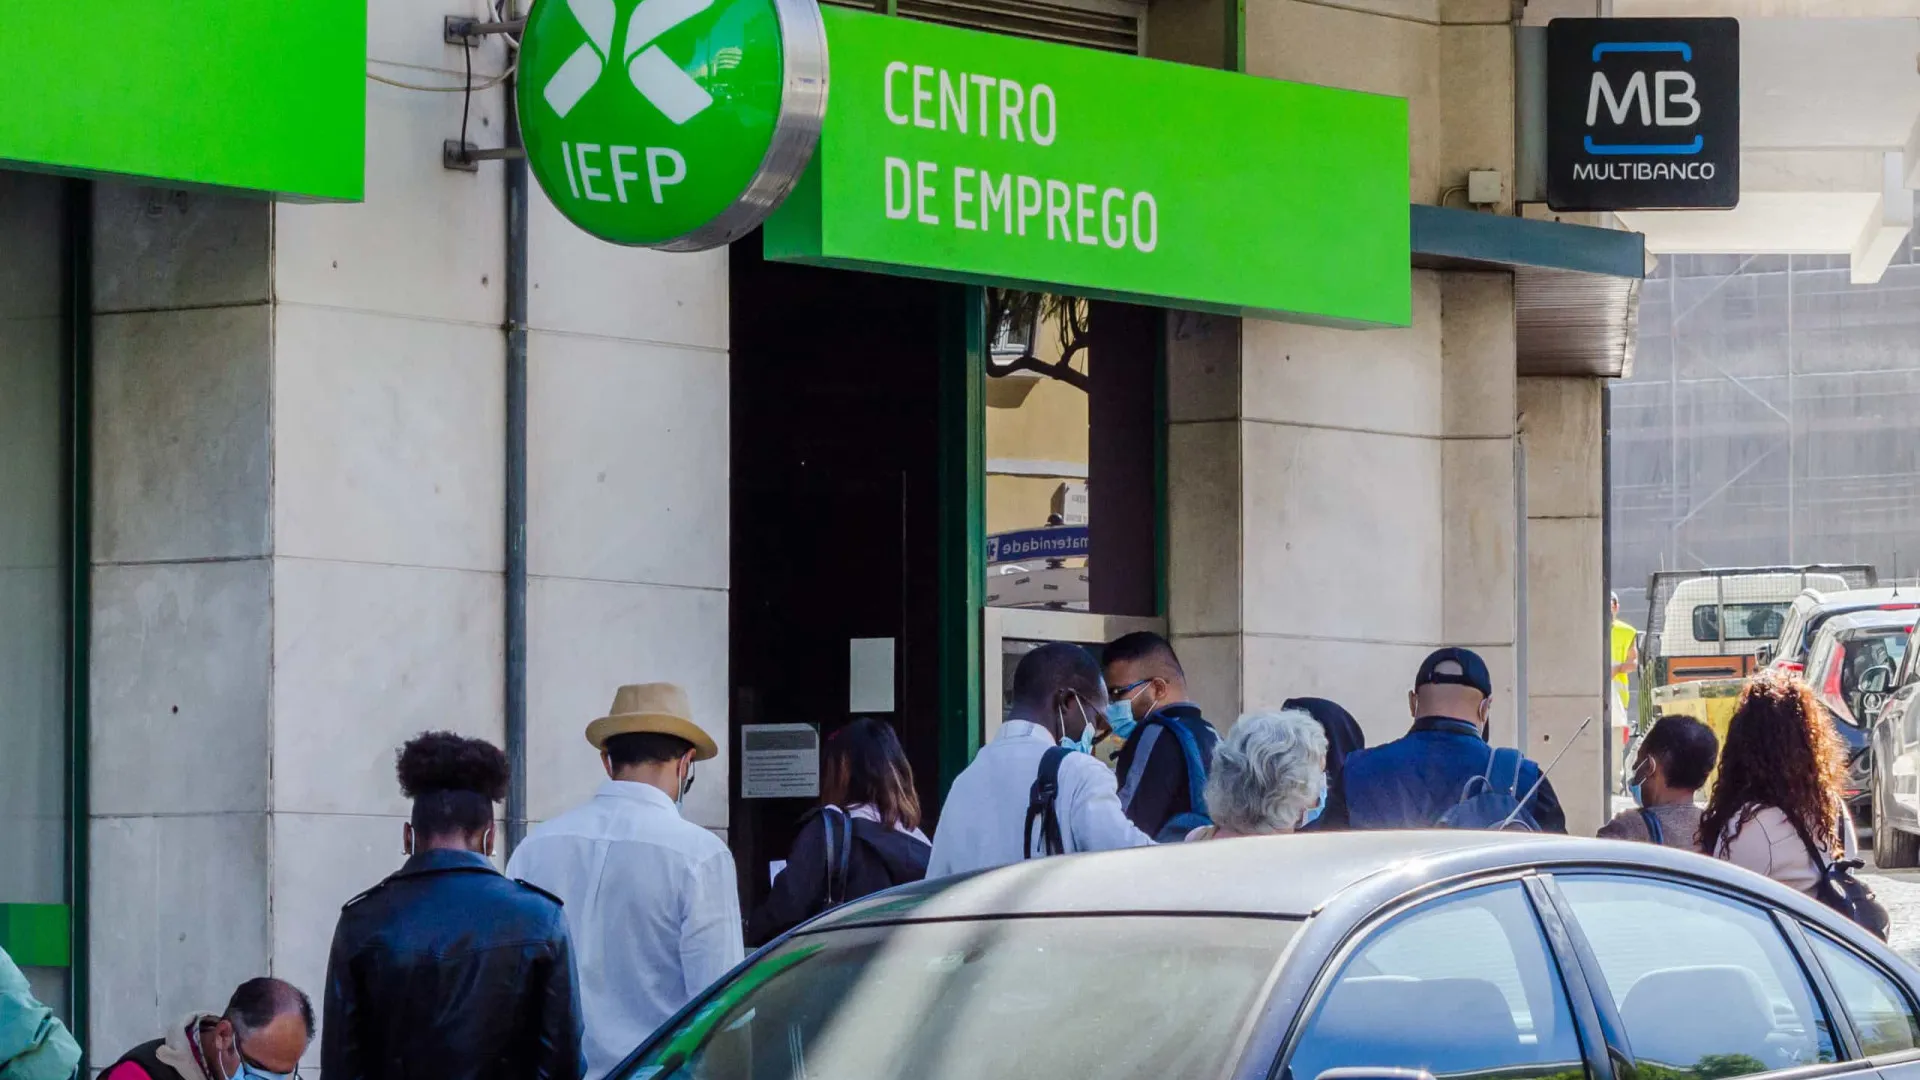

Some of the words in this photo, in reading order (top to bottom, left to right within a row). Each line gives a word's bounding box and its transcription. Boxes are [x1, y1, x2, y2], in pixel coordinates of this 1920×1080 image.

[884, 61, 1057, 146] CENTRO
[1585, 71, 1701, 126] MB
[562, 142, 687, 204] IEFP
[1573, 162, 1716, 181] MULTIBANCO
[884, 156, 940, 225] DE
[954, 166, 1158, 253] EMPREGO
